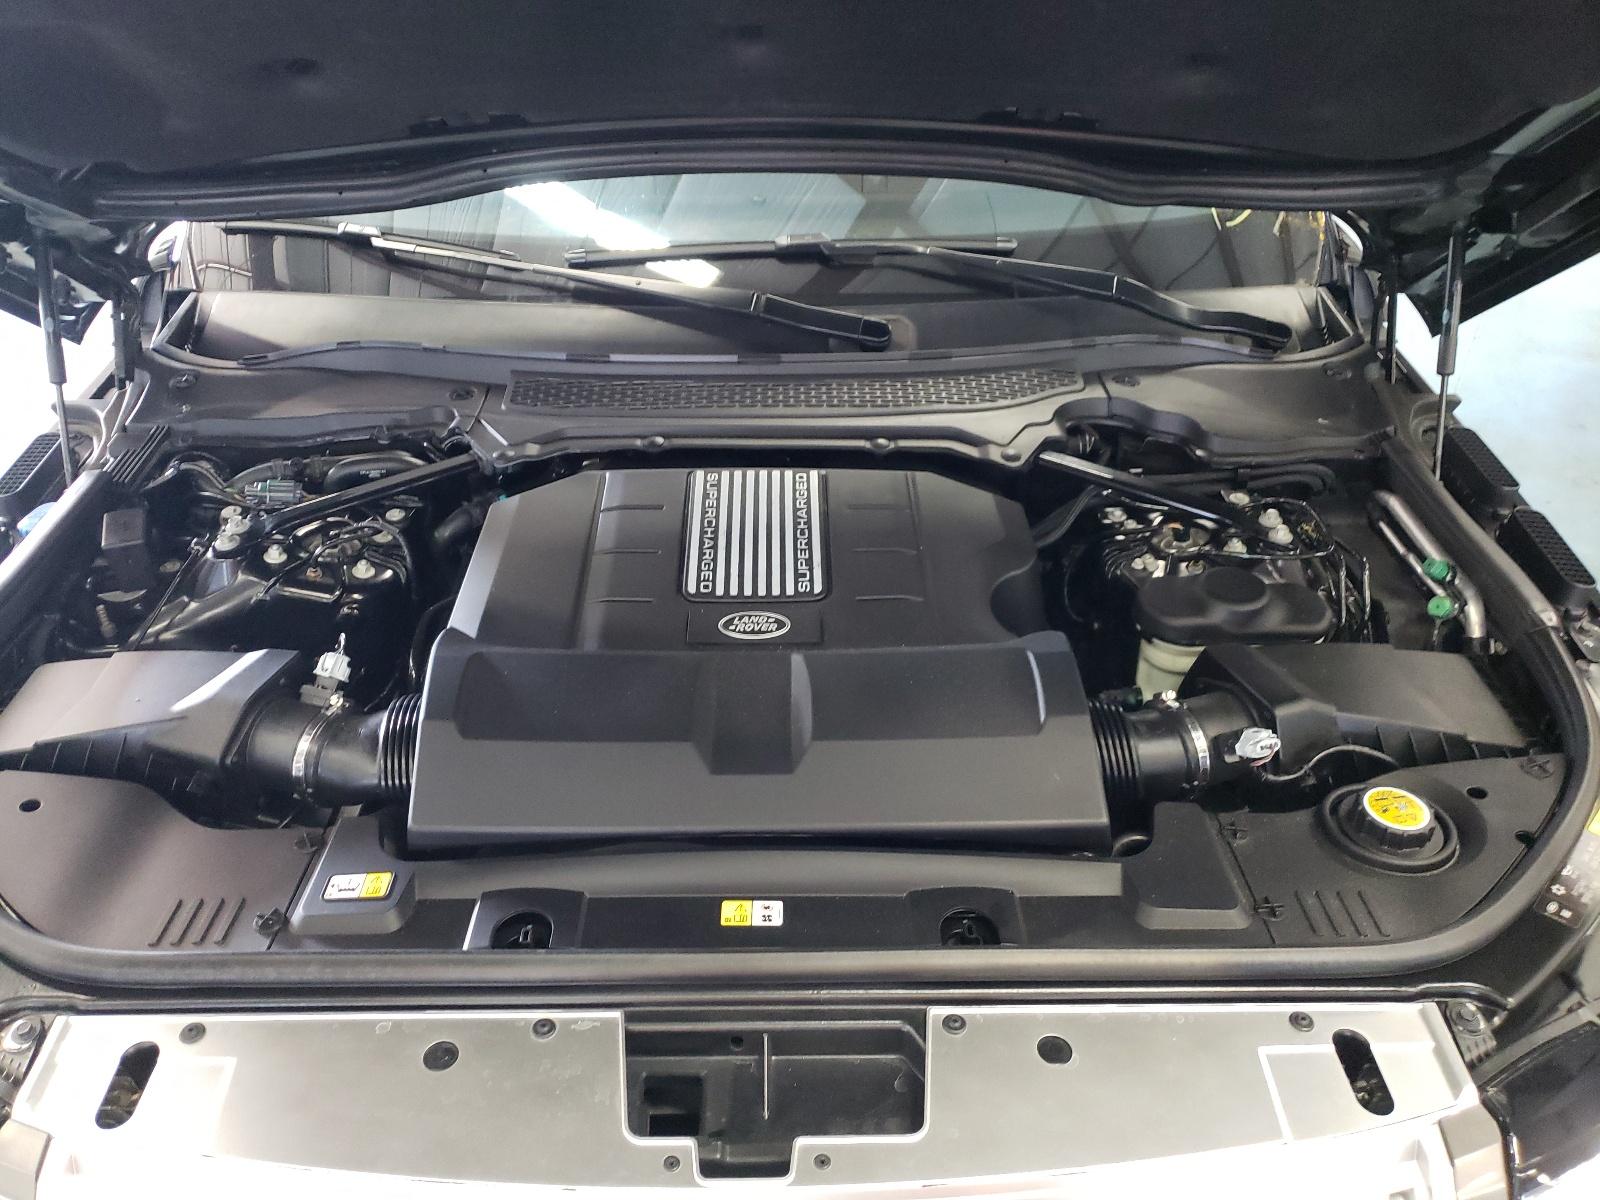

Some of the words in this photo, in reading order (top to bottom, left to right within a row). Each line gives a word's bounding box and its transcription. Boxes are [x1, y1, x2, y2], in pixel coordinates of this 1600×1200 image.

[699, 472, 719, 593] SUPERCHARGED
[795, 472, 811, 593] SUPERCHARGED
[733, 615, 769, 625] LAND
[735, 622, 778, 632] ROVER
